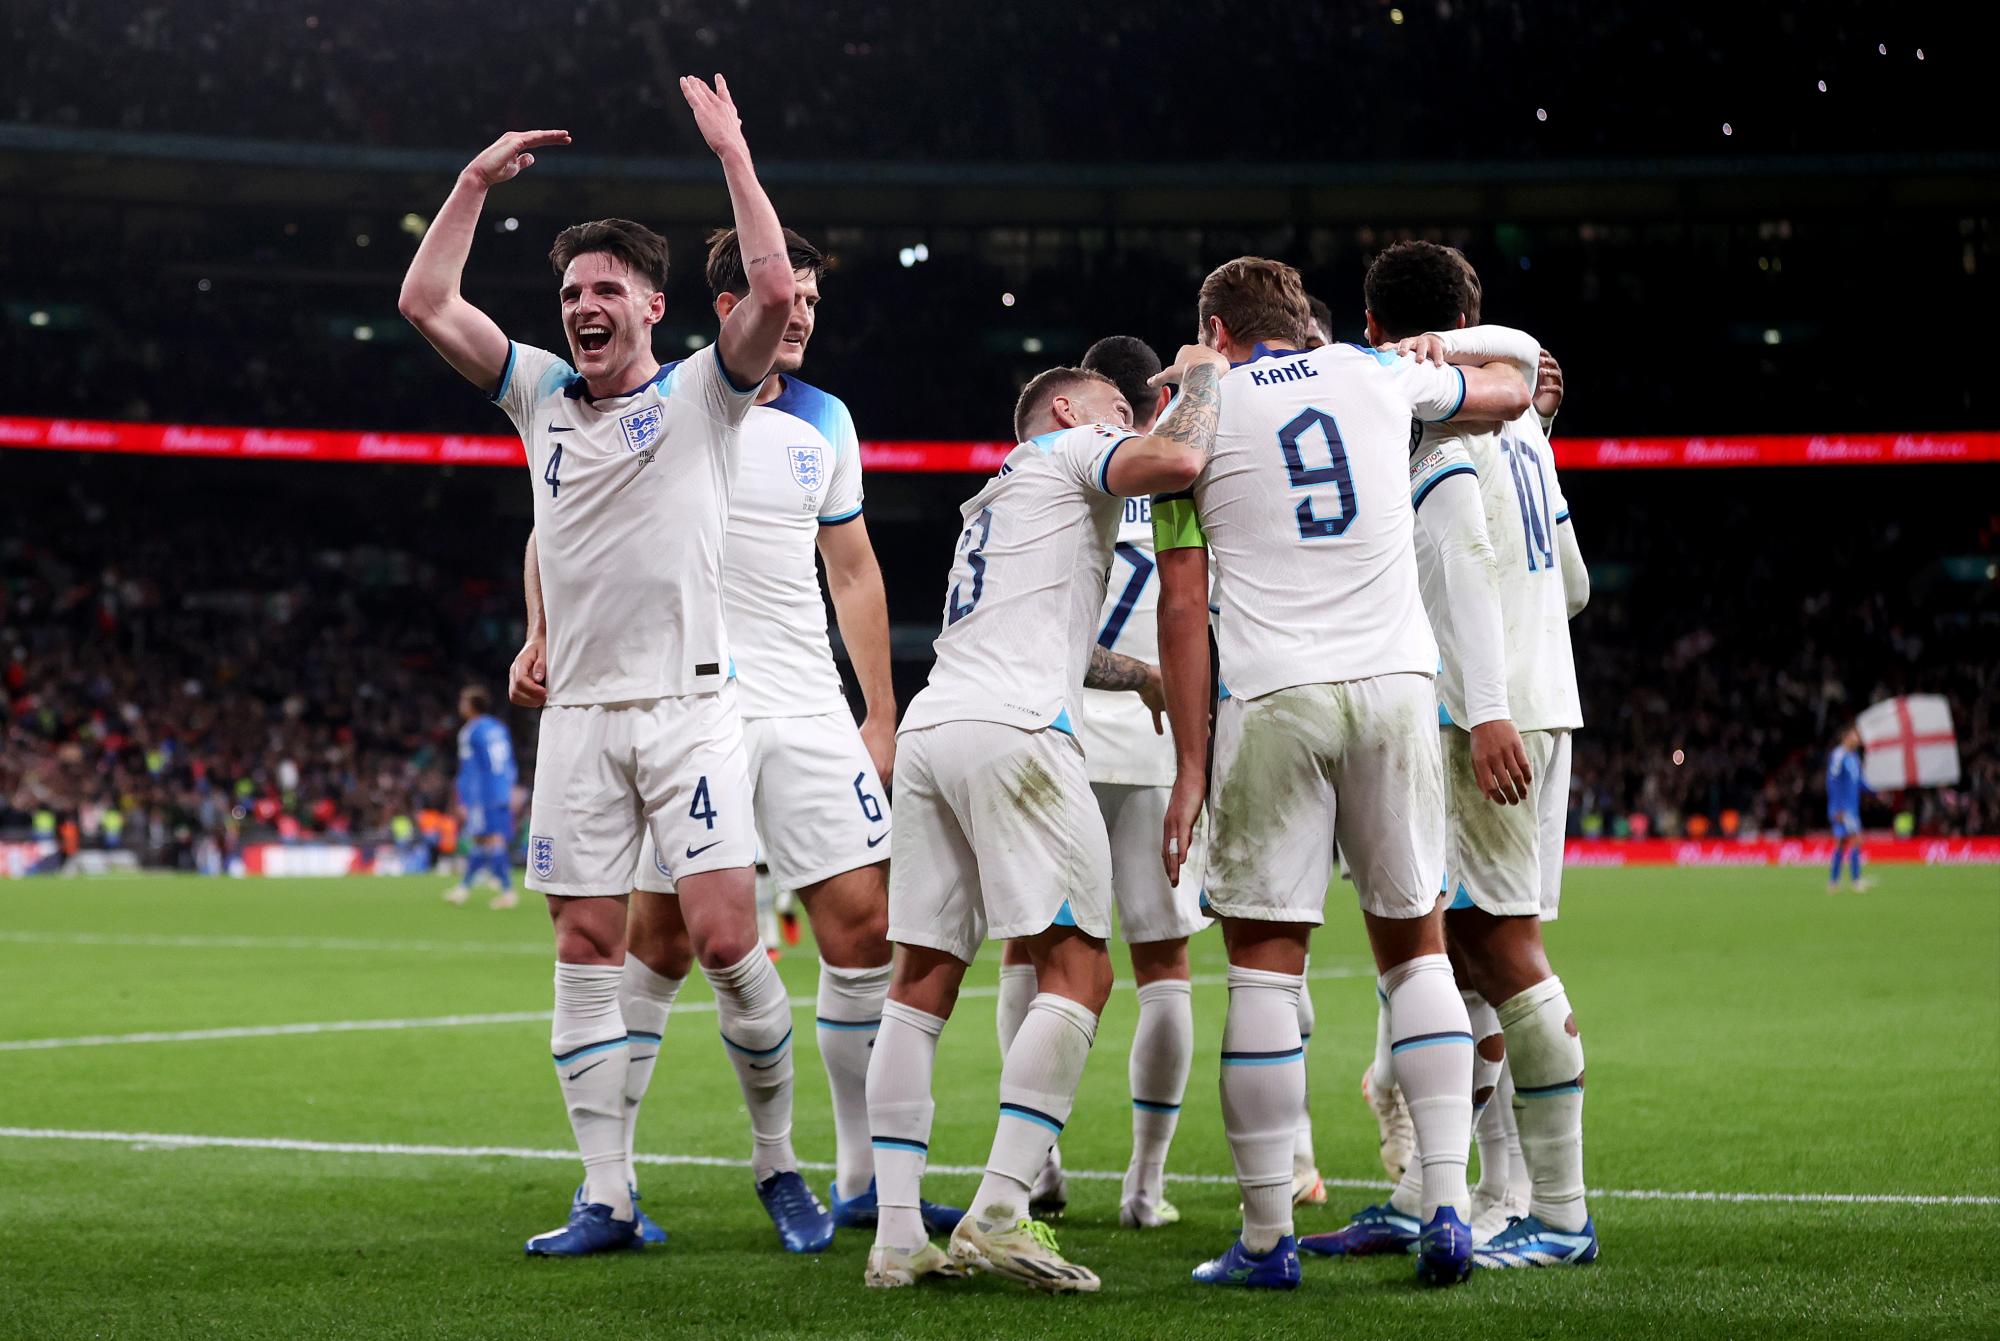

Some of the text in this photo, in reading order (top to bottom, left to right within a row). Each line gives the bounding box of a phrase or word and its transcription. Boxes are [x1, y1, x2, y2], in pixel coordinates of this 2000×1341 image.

[1250, 359, 1319, 386] KANE
[543, 442, 563, 498] 4
[1278, 406, 1359, 540] 9
[1501, 437, 1553, 571] 10
[1097, 541, 1155, 649] 7
[689, 776, 717, 830] 4
[852, 771, 883, 823] 6
